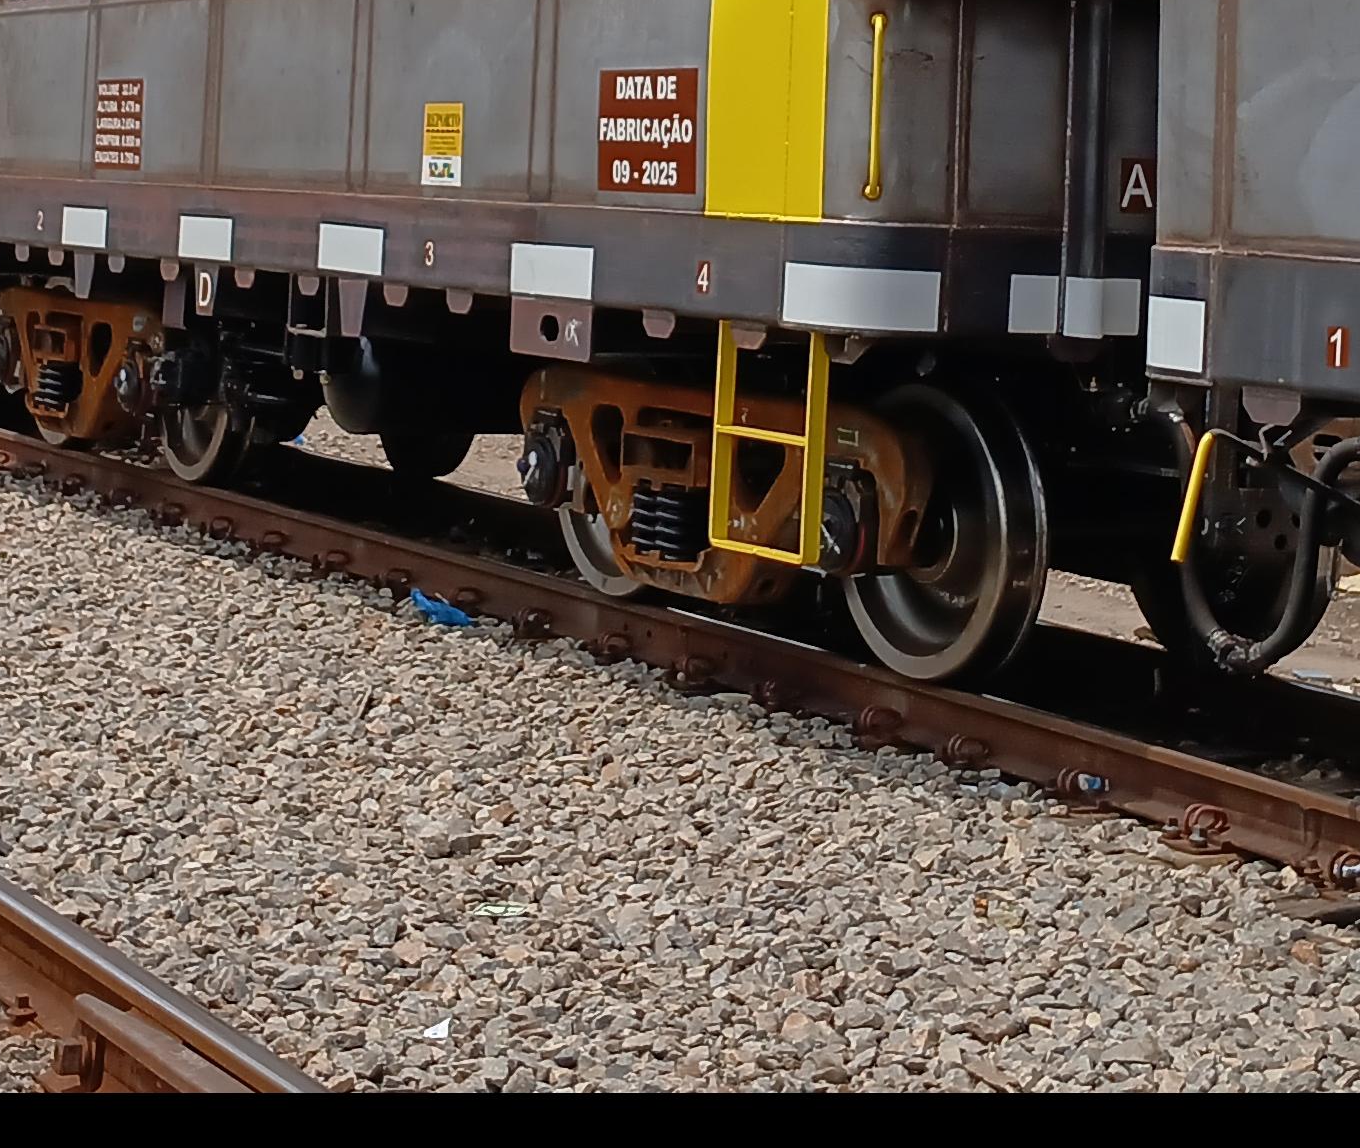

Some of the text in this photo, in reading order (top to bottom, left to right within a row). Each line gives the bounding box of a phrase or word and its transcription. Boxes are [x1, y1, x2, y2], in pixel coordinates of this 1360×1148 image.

[616, 76, 677, 100] DATA DE
[599, 113, 693, 149] FABRICAÇÃO
[612, 159, 631, 184] 09
[641, 160, 678, 187] 2025
[1121, 163, 1153, 208] A
[425, 241, 434, 266] 3
[199, 272, 211, 307] D
[697, 263, 709, 292] 4
[1330, 328, 1342, 367] 1
